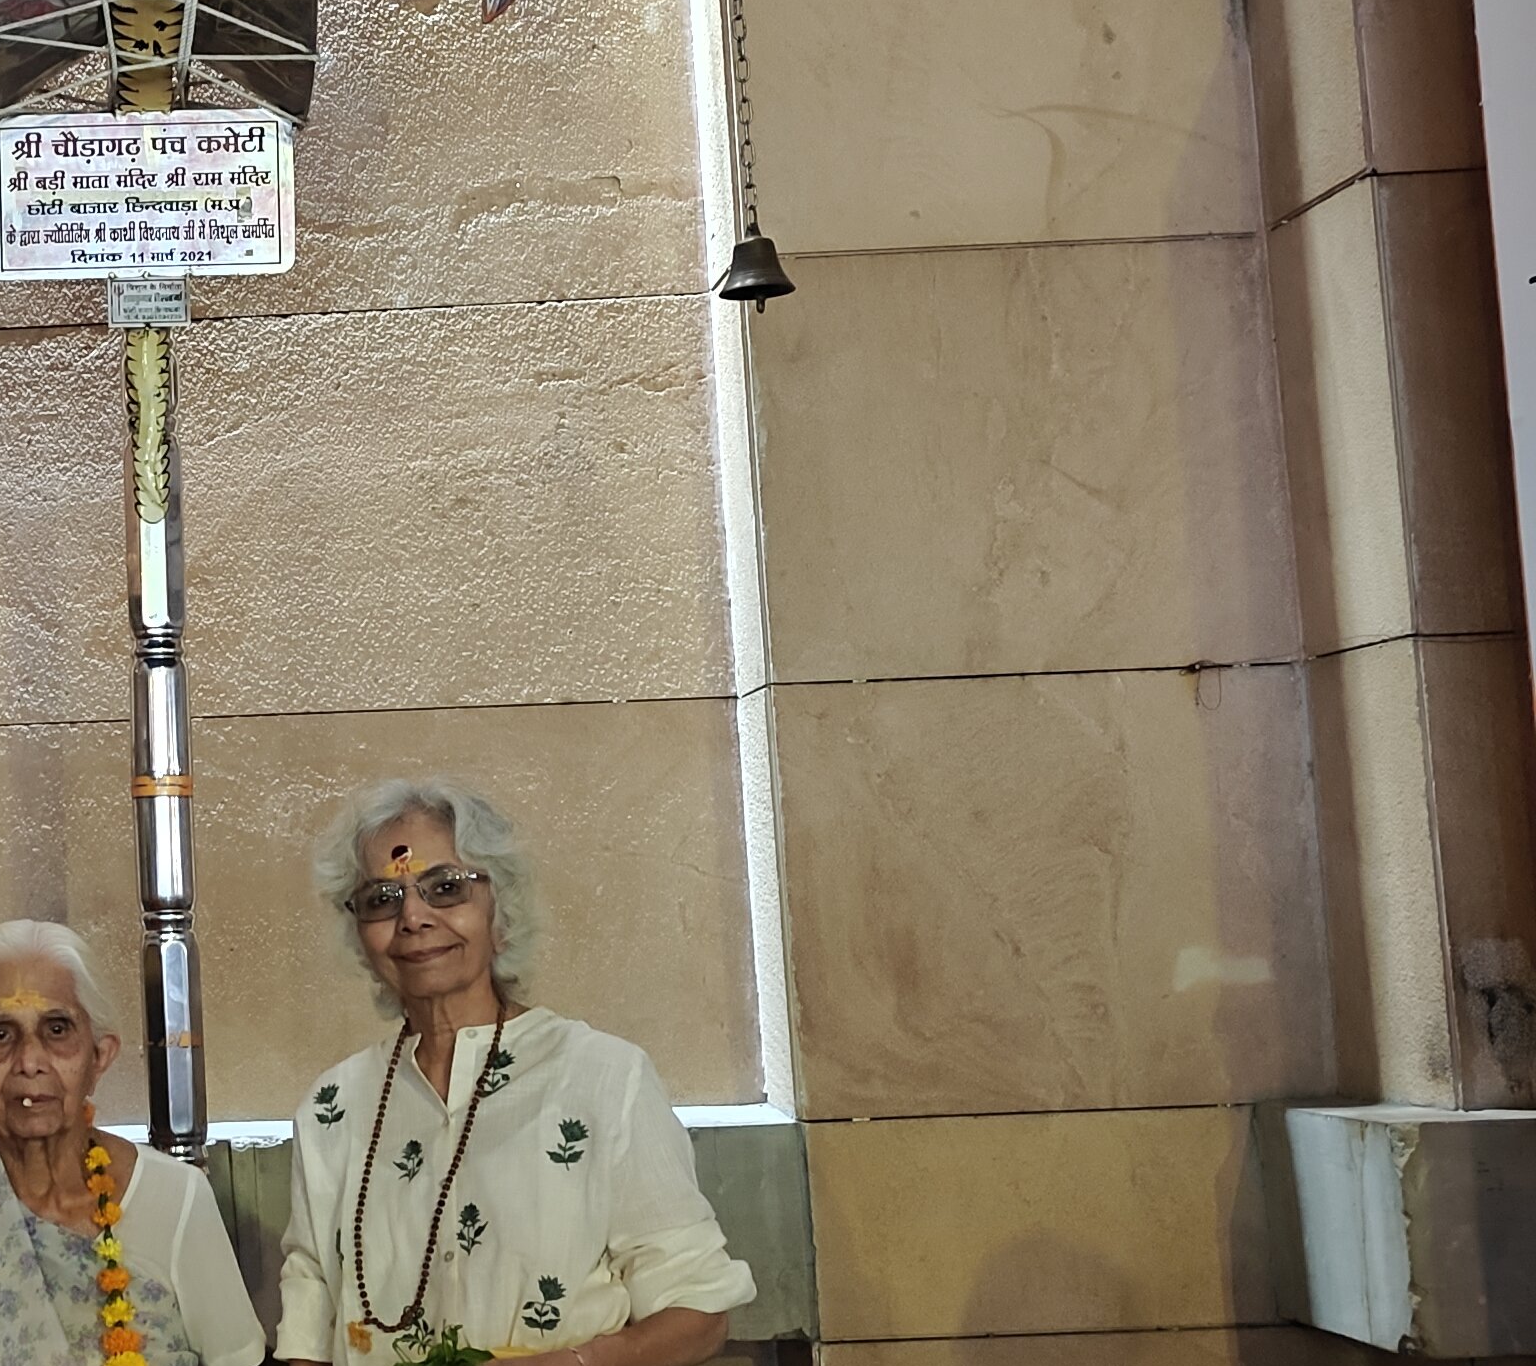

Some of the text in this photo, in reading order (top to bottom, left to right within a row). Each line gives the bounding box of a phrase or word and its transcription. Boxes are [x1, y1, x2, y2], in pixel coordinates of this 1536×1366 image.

[12, 127, 265, 164] श्री चौड़ागढ़ पंच कमेटी
[7, 165, 271, 195] श्री बड़ी माता मंदिर श्री राम मंदिर
[27, 199, 63, 215] छोटी
[69, 202, 119, 214] बाजार
[125, 197, 198, 215] छिन्दवाड़ा
[6, 224, 16, 244] के
[19, 230, 40, 246] द्वारा
[94, 222, 106, 243] श्री
[109, 221, 135, 242] काशी
[139, 221, 180, 241] विश्वनाथ
[183, 220, 195, 240] जी
[198, 219, 206, 239] में
[209, 219, 238, 244] त्रिशूल
[241, 218, 275, 238] समर्पित
[71, 248, 212, 263] दिनांक 11 मार्च 2021
